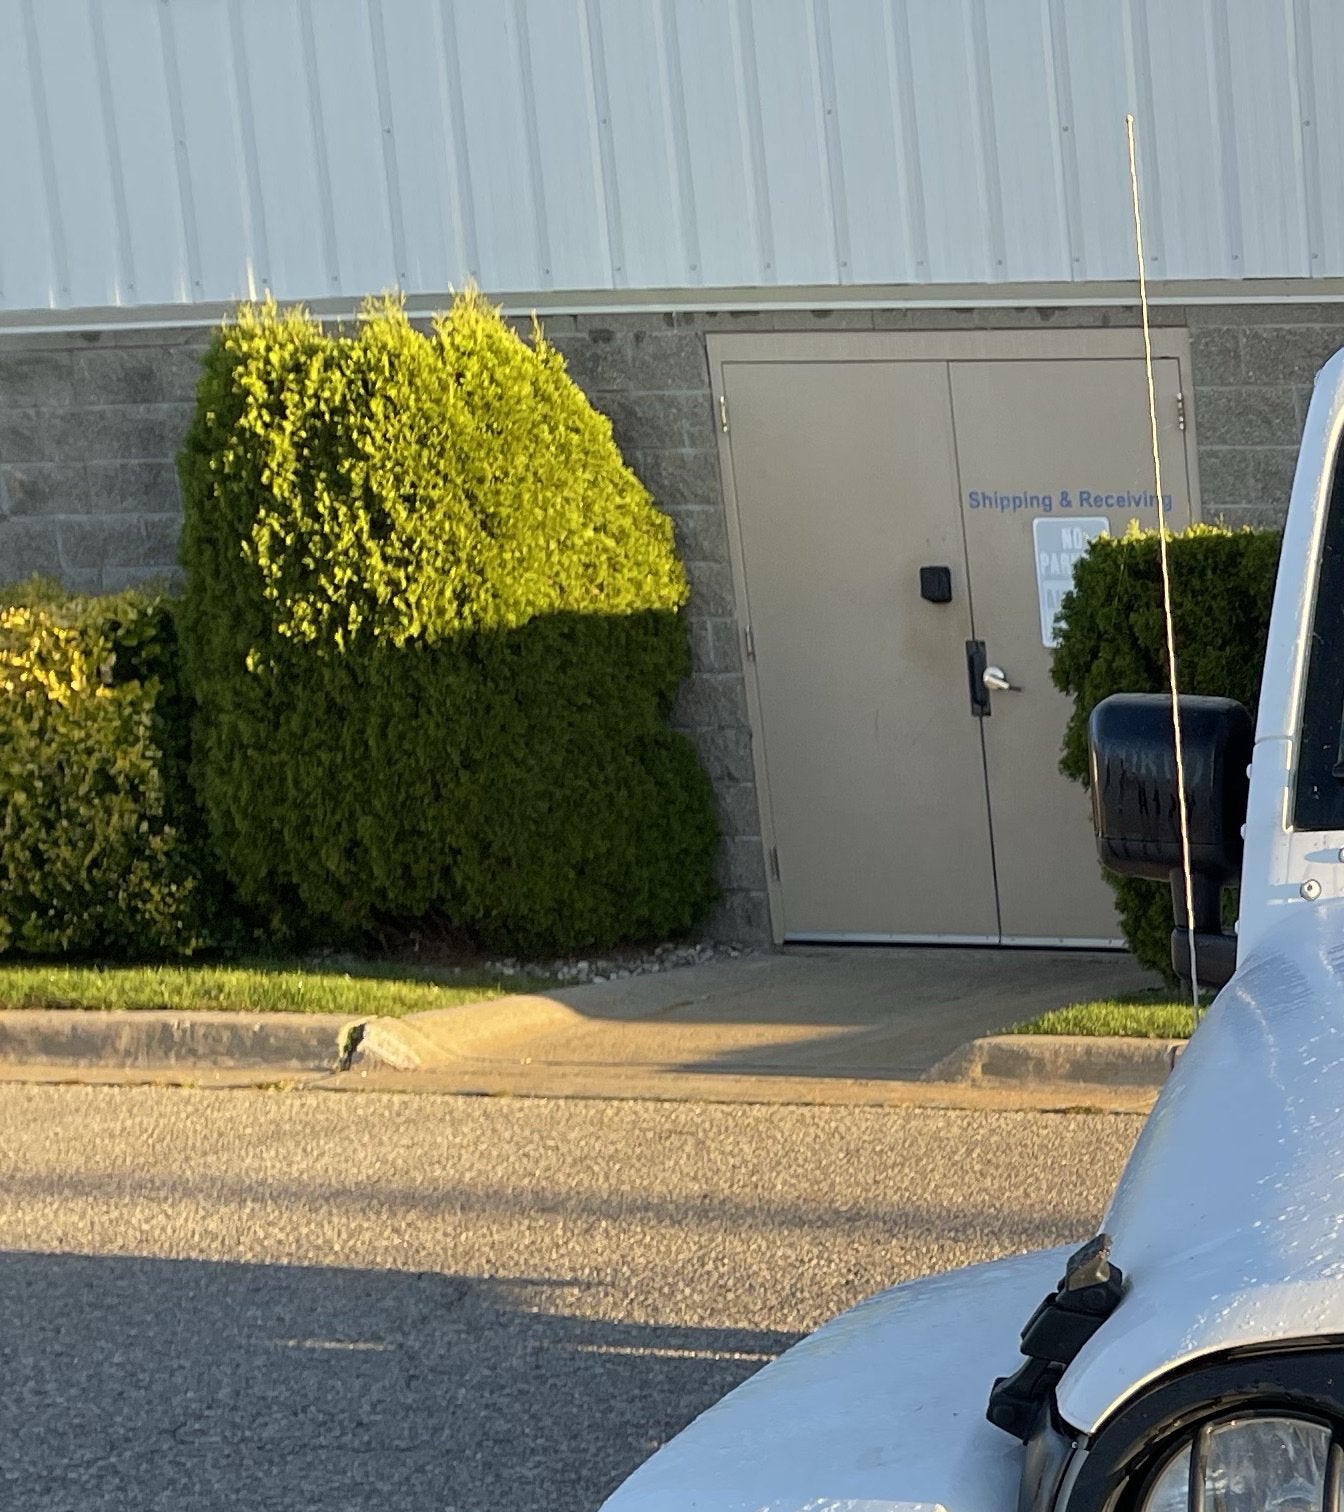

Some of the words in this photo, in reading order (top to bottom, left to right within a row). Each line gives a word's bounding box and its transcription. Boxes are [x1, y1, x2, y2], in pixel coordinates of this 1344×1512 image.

[968, 491, 1053, 512] Shipping
[1059, 490, 1073, 508] &
[1061, 527, 1082, 549] NO
